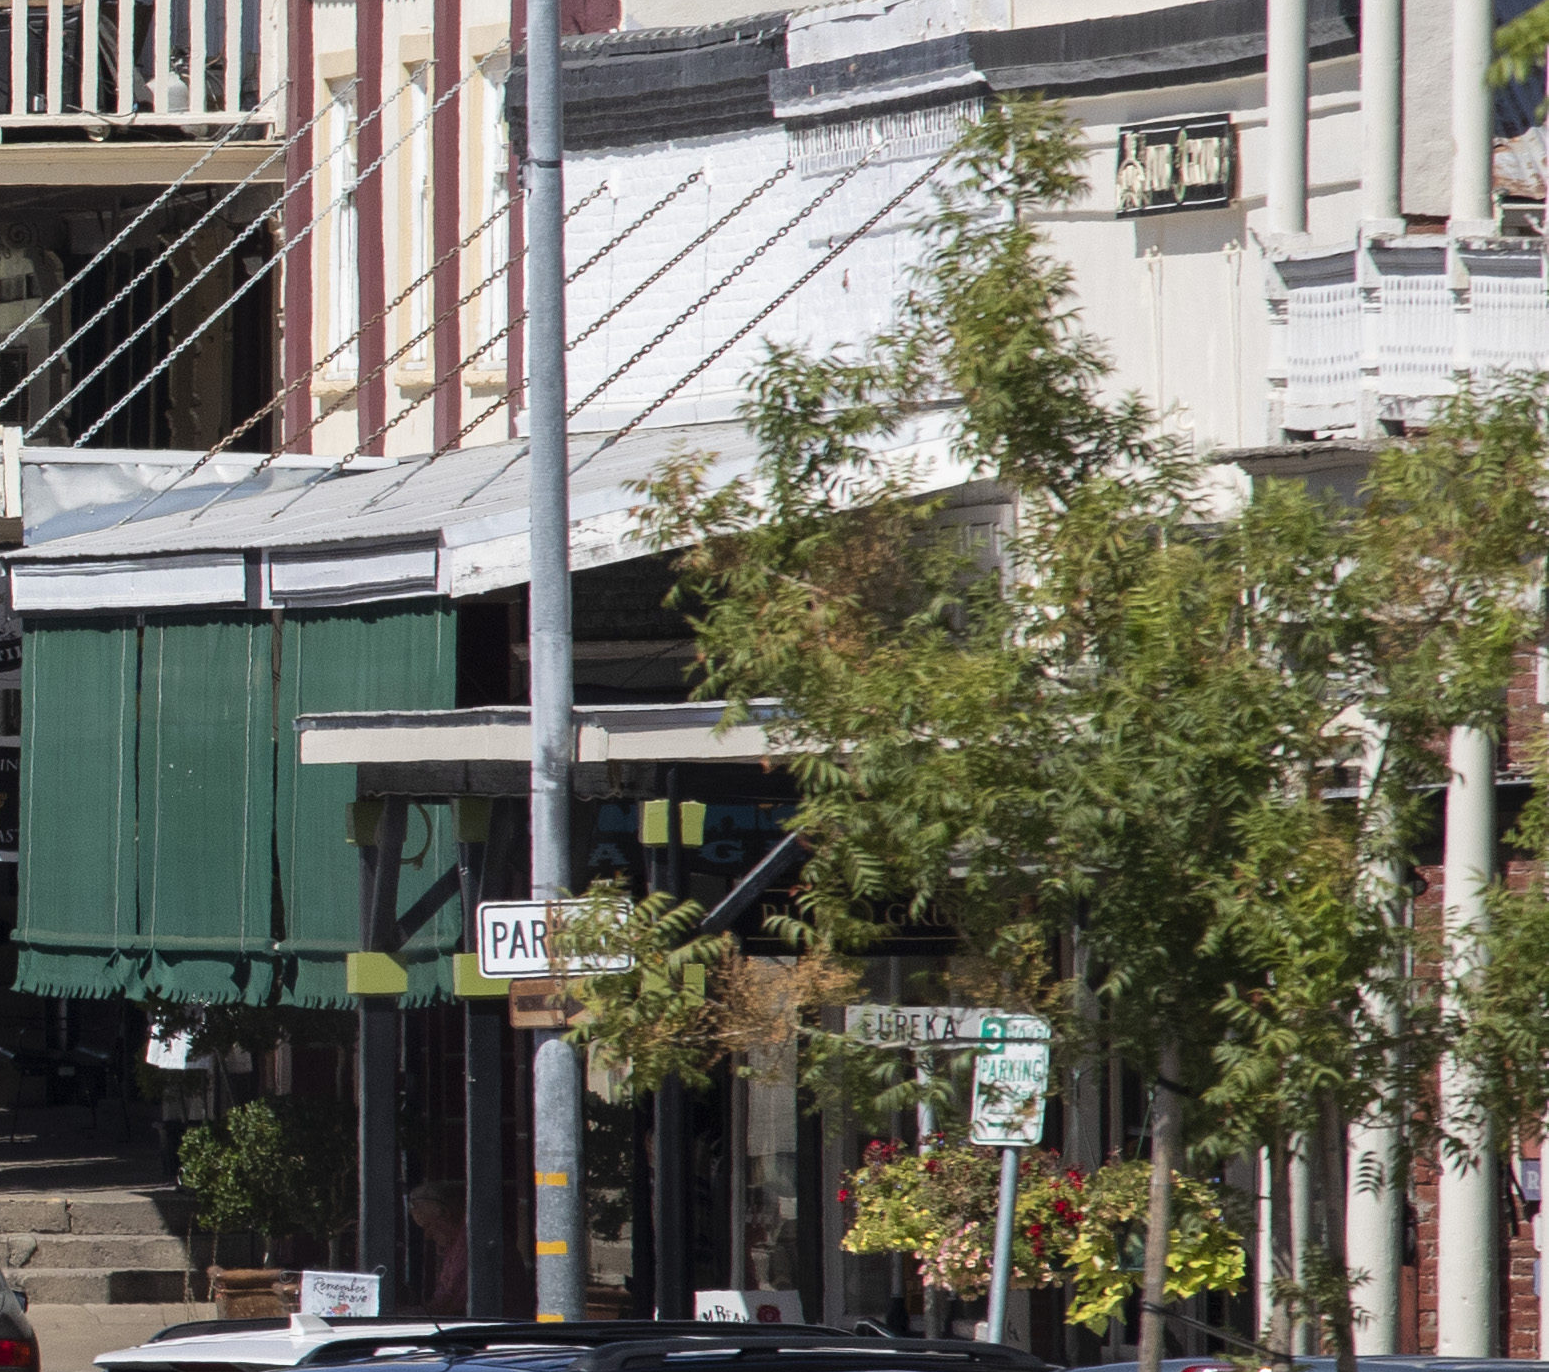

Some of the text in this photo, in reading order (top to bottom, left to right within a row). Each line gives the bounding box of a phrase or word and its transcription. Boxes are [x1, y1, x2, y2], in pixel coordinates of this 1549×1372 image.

[866, 1013, 956, 1040] EUREKA
[987, 1023, 1002, 1050] 3
[981, 1059, 1043, 1082] PARKING
[313, 1277, 367, 1295] Remember
[337, 1292, 368, 1303] Brave
